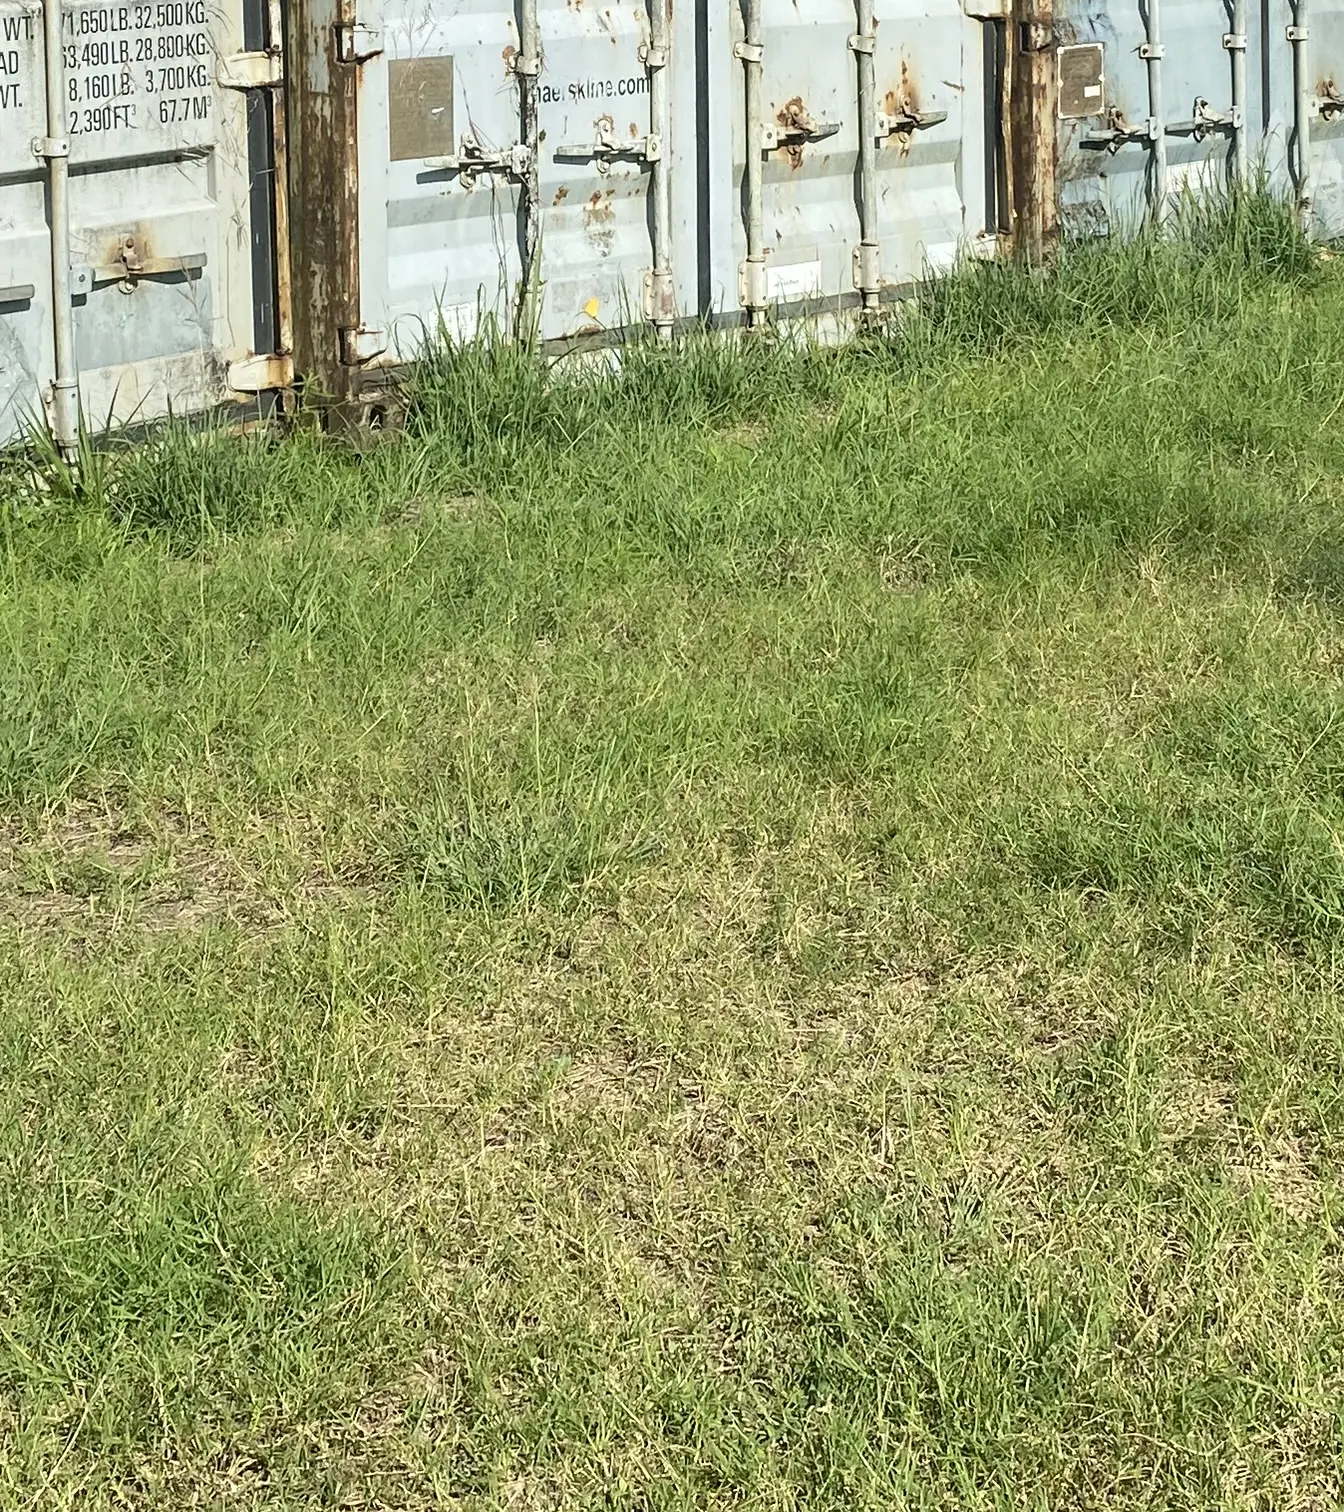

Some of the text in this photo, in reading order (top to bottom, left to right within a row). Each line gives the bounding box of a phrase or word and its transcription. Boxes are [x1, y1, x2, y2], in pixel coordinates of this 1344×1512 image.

[4, 15, 35, 41] WT.
[110, 7, 133, 32] LB.
[135, 2, 183, 30] 32,500
[186, 0, 210, 24] KG.
[111, 40, 134, 64] LB.
[135, 37, 184, 62] 28,800
[186, 33, 210, 56] KG.
[69, 74, 109, 103] 8,160
[145, 68, 184, 94] 3,700
[187, 64, 211, 88] KG.
[70, 106, 111, 136] 2,390
[159, 97, 191, 124] 67.7
